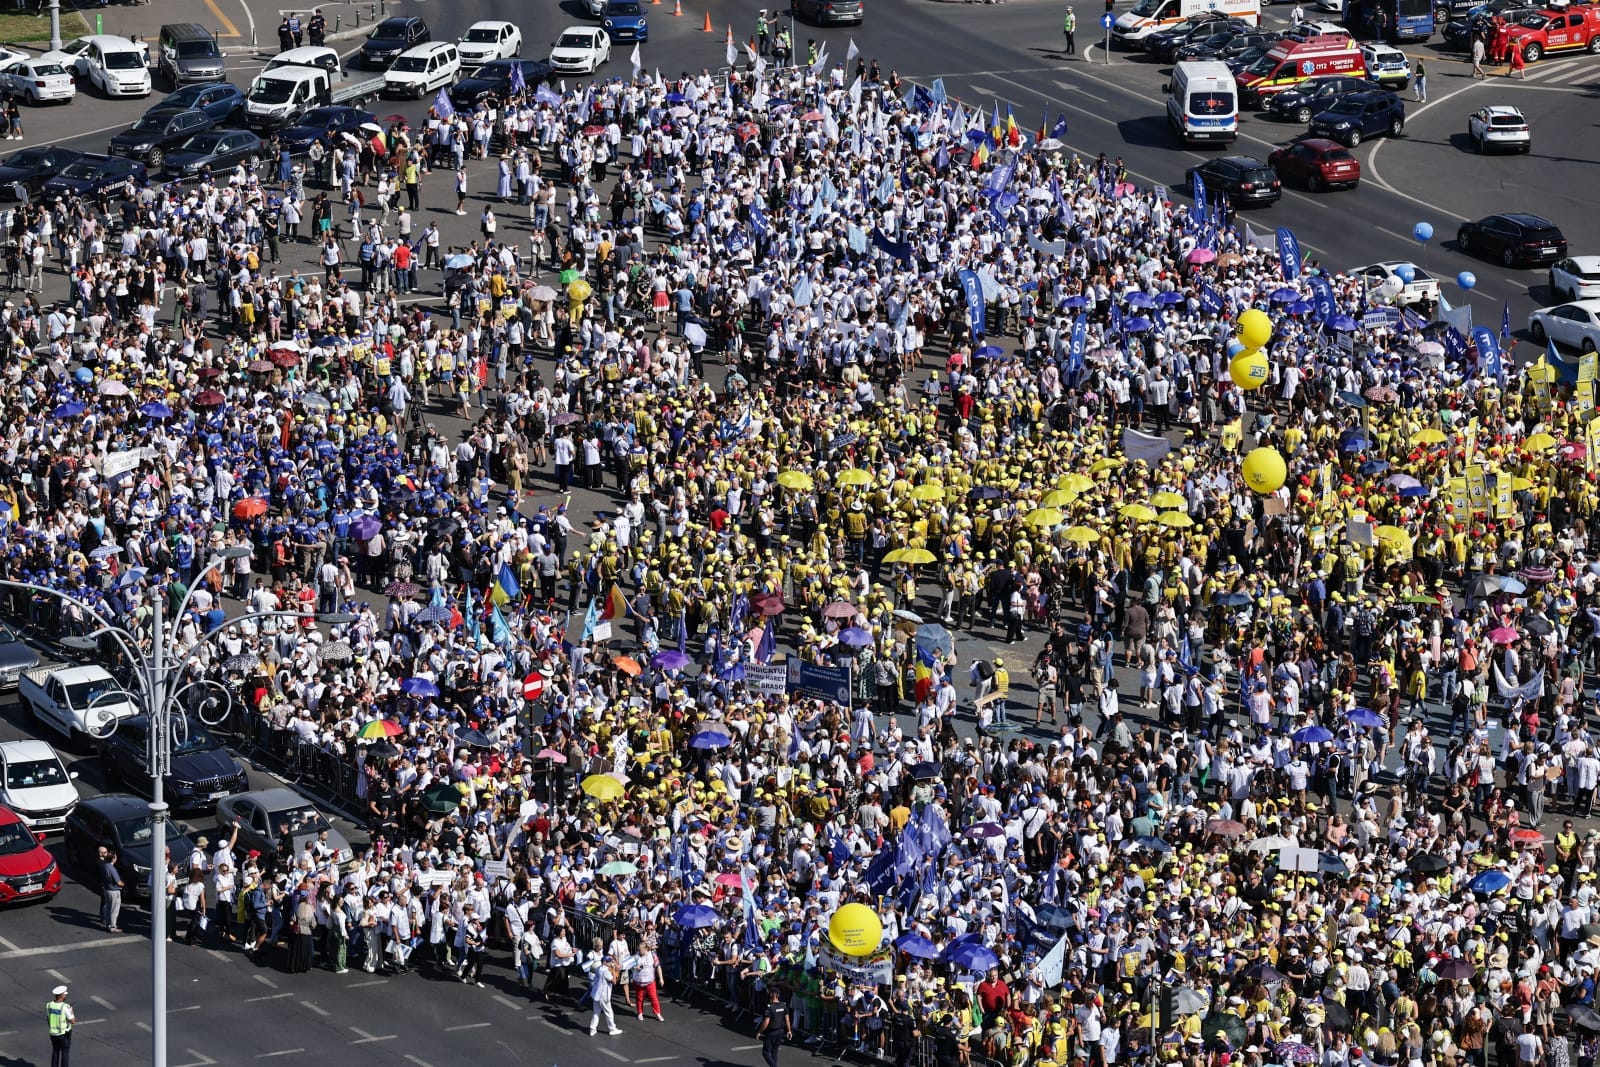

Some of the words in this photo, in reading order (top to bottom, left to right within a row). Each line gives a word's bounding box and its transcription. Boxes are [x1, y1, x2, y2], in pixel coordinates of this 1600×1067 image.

[1250, 367, 1266, 377] FSE
[744, 664, 786, 675] SINDICATUL
[830, 962, 864, 978] SECTOR
